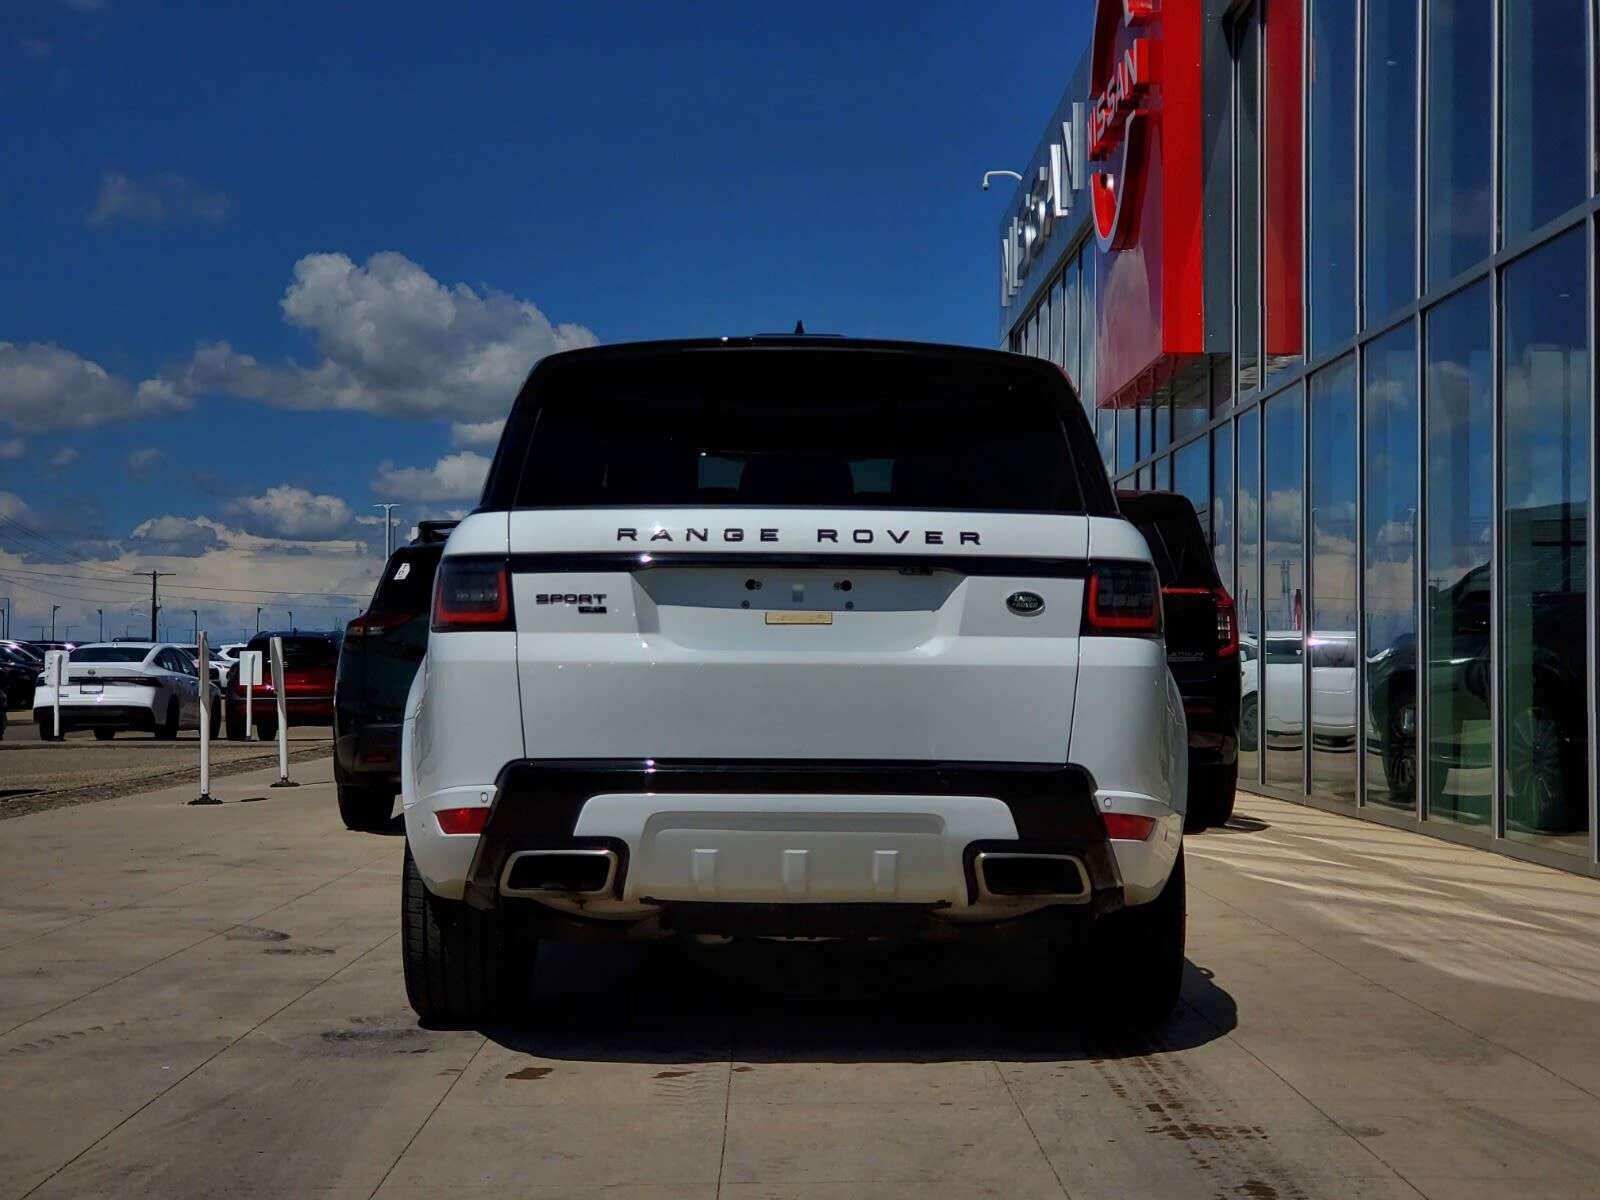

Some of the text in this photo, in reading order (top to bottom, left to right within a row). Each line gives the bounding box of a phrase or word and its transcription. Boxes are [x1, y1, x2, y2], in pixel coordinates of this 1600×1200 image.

[1087, 38, 1147, 161] NISSAN
[617, 528, 982, 545] RANGE ROVER
[536, 594, 607, 605] SPORT
